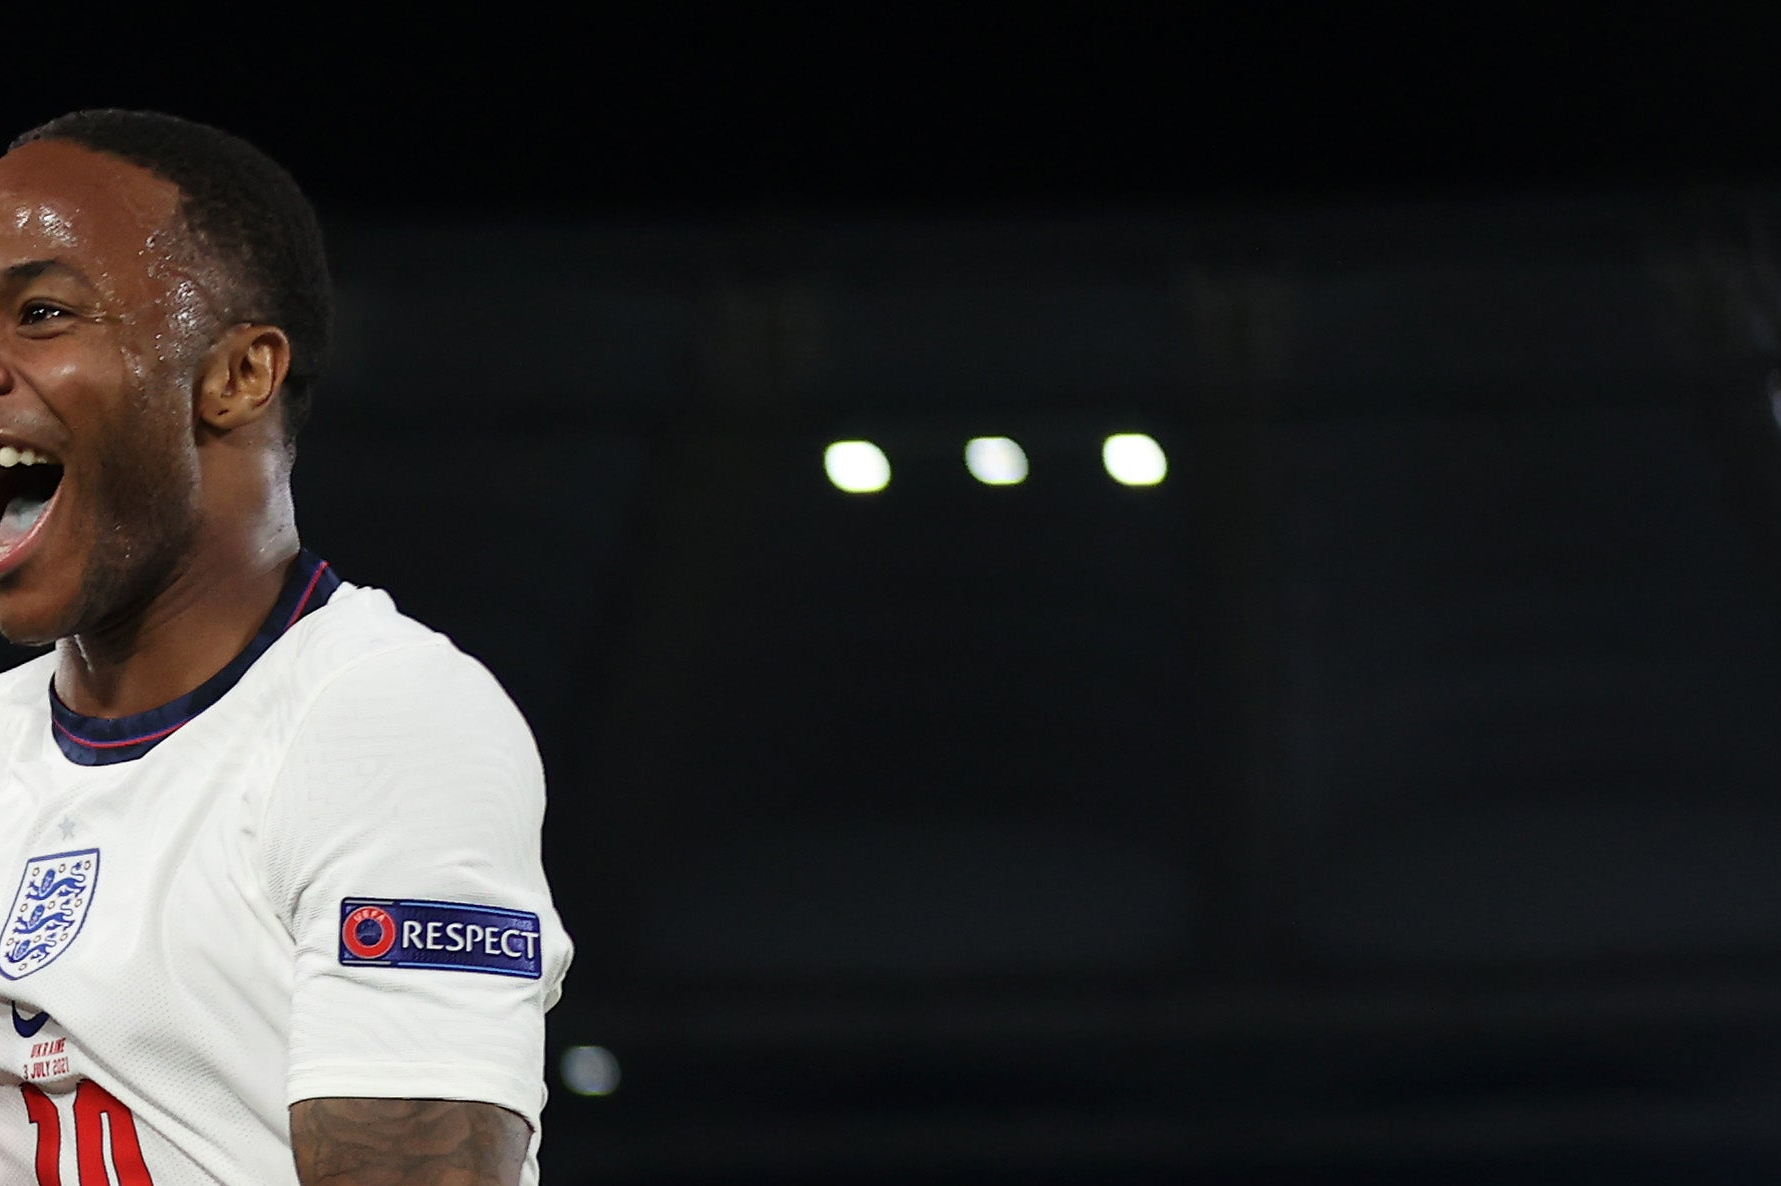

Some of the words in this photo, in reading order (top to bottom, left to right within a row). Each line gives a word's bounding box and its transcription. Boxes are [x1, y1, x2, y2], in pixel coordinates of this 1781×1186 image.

[353, 909, 386, 922] UEFA
[402, 920, 539, 959] RESPECT
[31, 1037, 66, 1058] UKRAINE
[23, 1064, 28, 1079] 3
[31, 1061, 50, 1078] JULY
[53, 1056, 69, 1075] 2021
